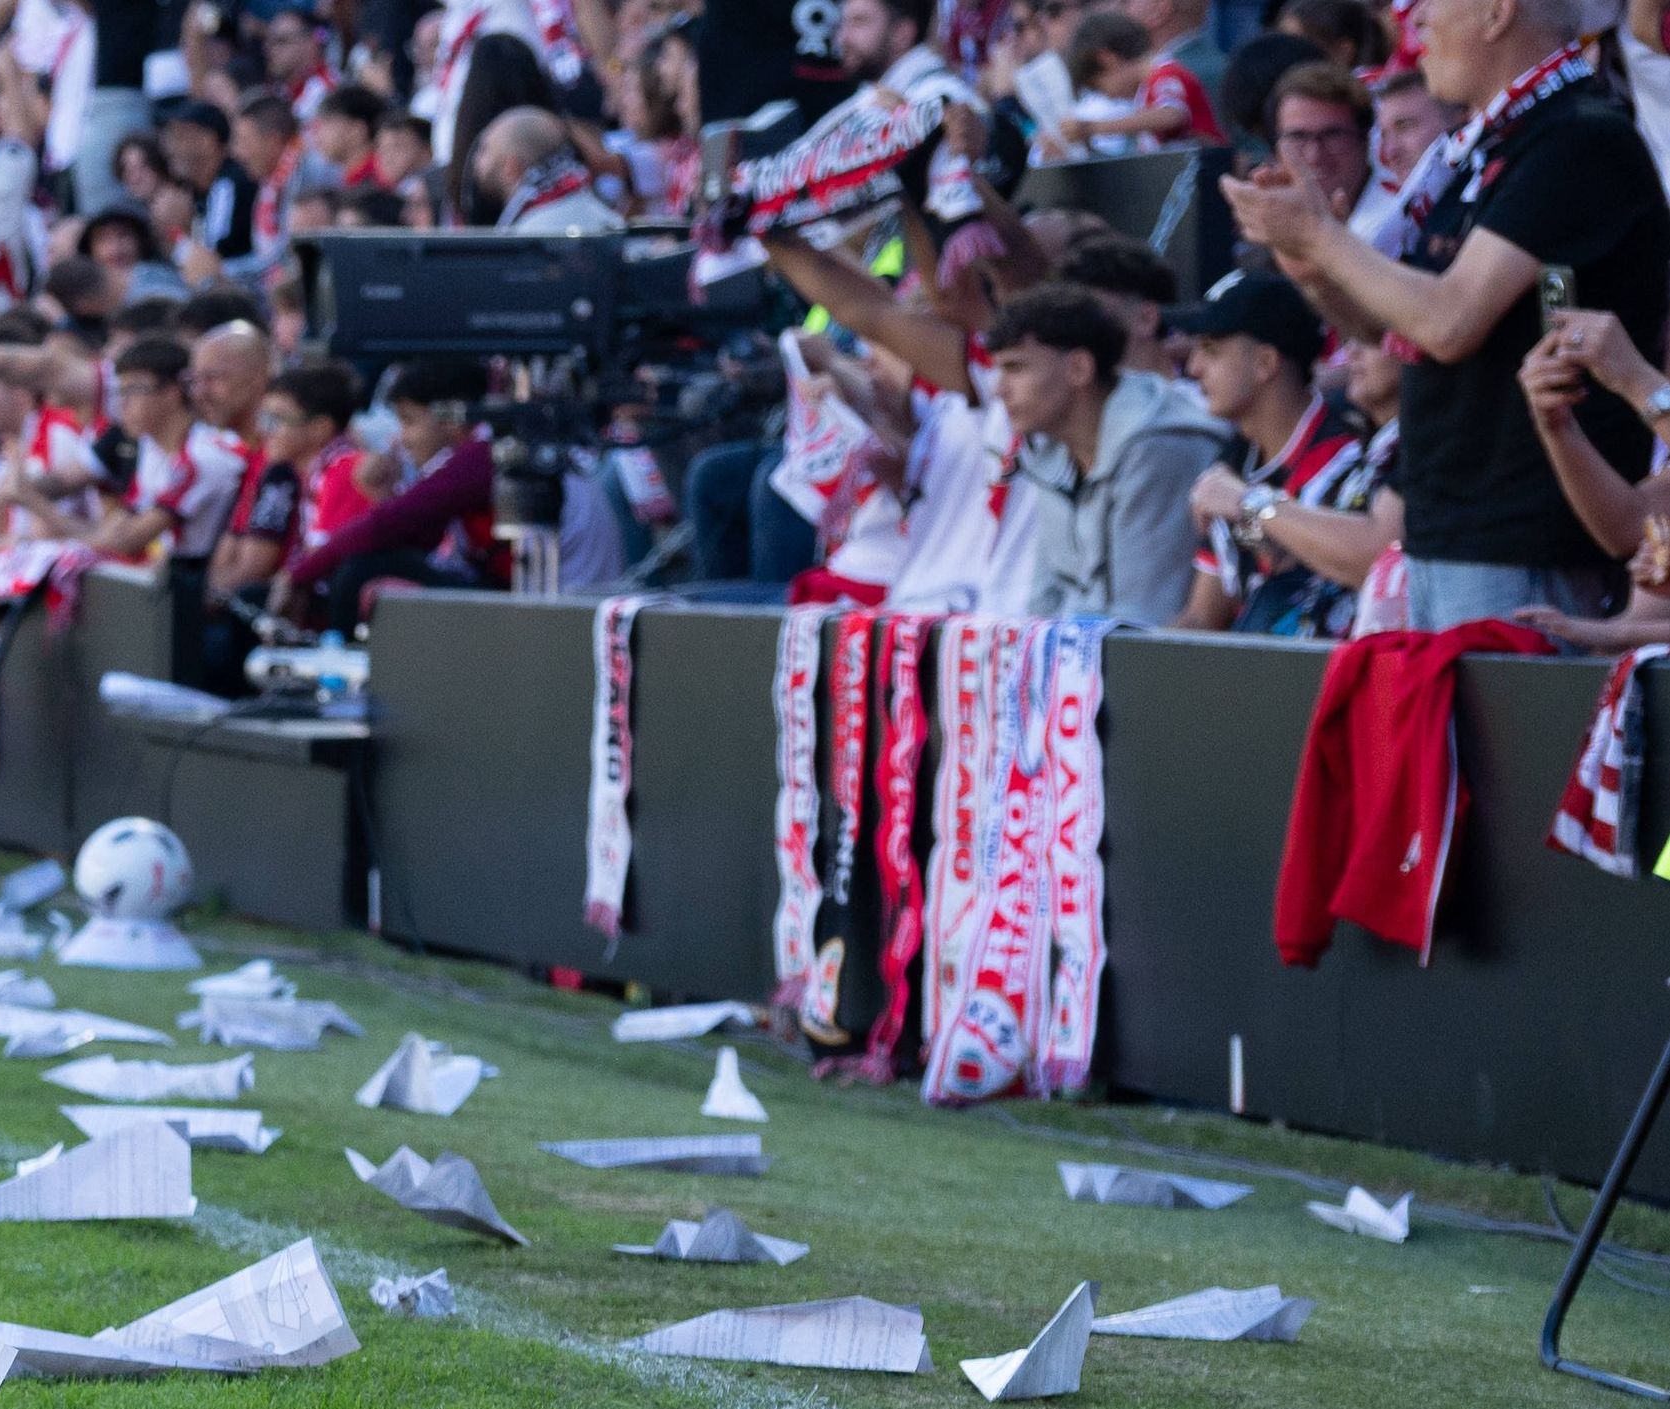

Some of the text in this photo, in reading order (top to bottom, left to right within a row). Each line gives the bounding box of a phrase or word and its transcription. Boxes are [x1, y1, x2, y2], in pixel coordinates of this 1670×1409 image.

[831, 630, 868, 904] VALLECANO
[1057, 694, 1085, 917] RAYO
[981, 788, 1029, 982] RAYO
